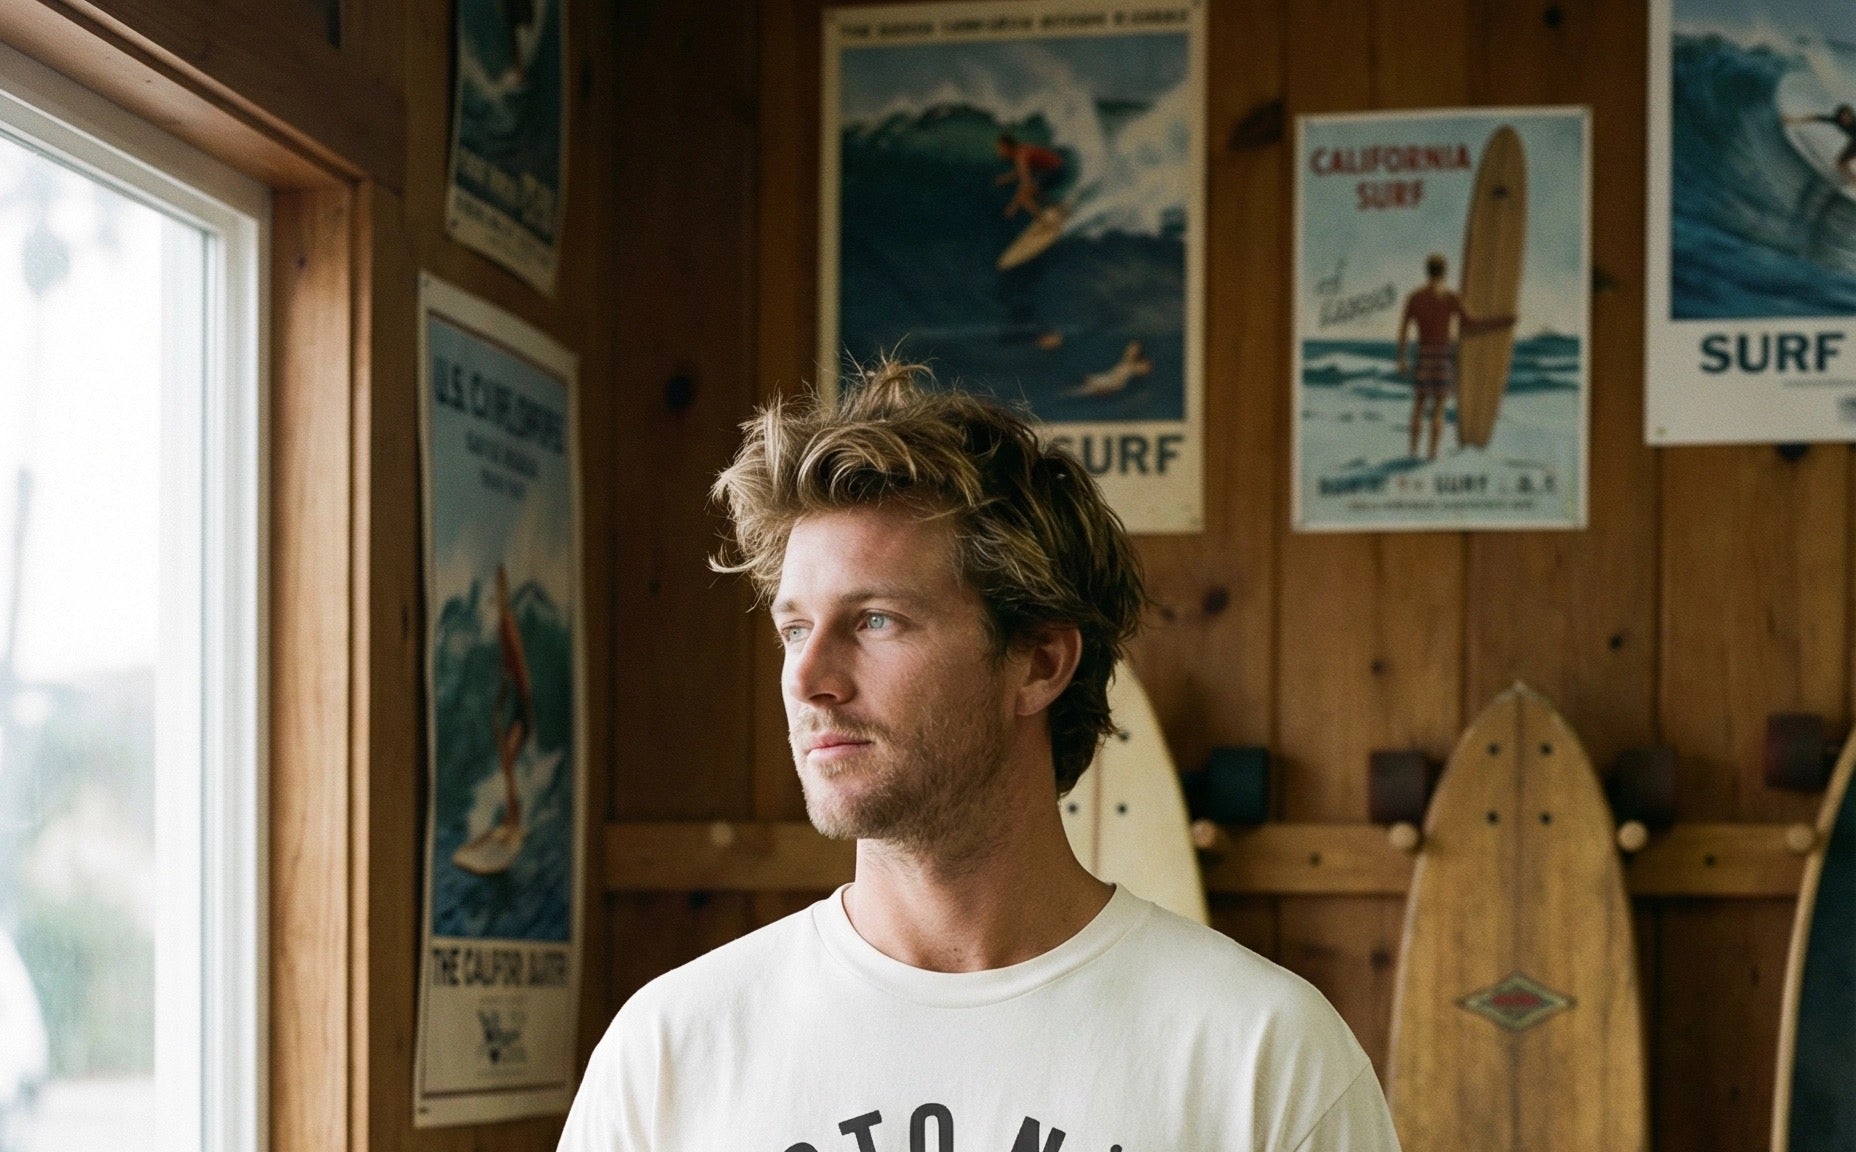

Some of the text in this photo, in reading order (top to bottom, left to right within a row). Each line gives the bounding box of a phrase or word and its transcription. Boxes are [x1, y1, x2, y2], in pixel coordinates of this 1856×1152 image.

[1309, 144, 1471, 177] CALIFORNIA
[1356, 179, 1424, 210] SURF
[1698, 331, 1845, 374] SURF
